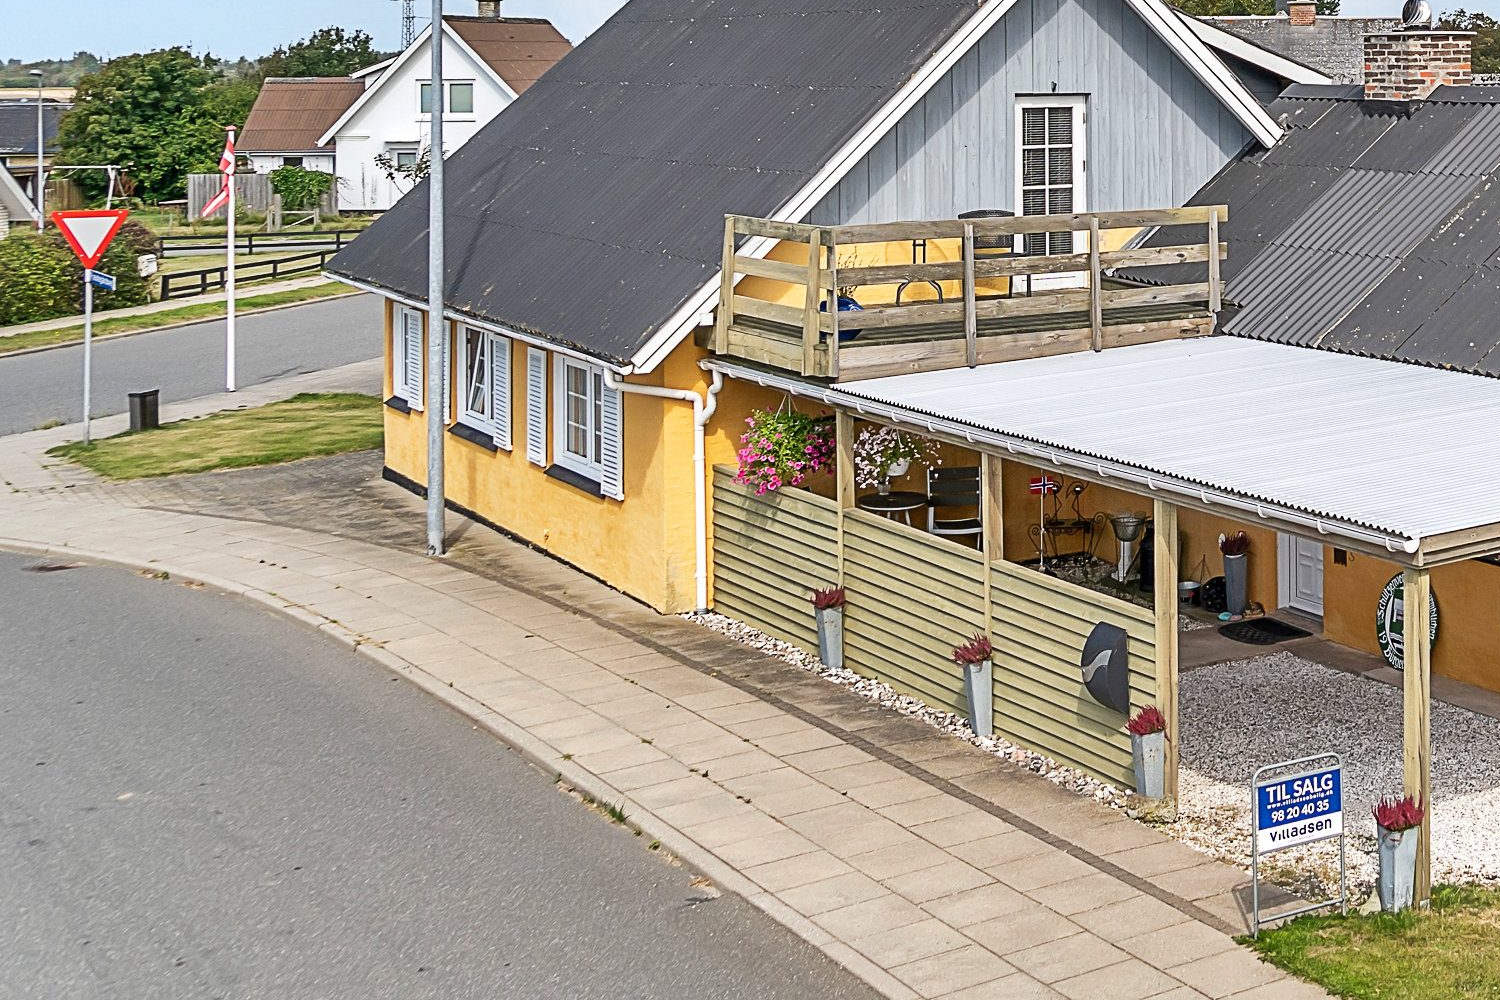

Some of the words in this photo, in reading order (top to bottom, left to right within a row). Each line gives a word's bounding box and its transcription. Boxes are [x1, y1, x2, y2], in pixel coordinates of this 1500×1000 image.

[1265, 783, 1291, 803] TIL
[1293, 773, 1333, 797] SALG
[1271, 809, 1285, 823] 98
[1286, 806, 1300, 820] 20
[1301, 802, 1315, 815] 40
[1316, 798, 1330, 812] 35
[1269, 818, 1332, 843] Villadsen
